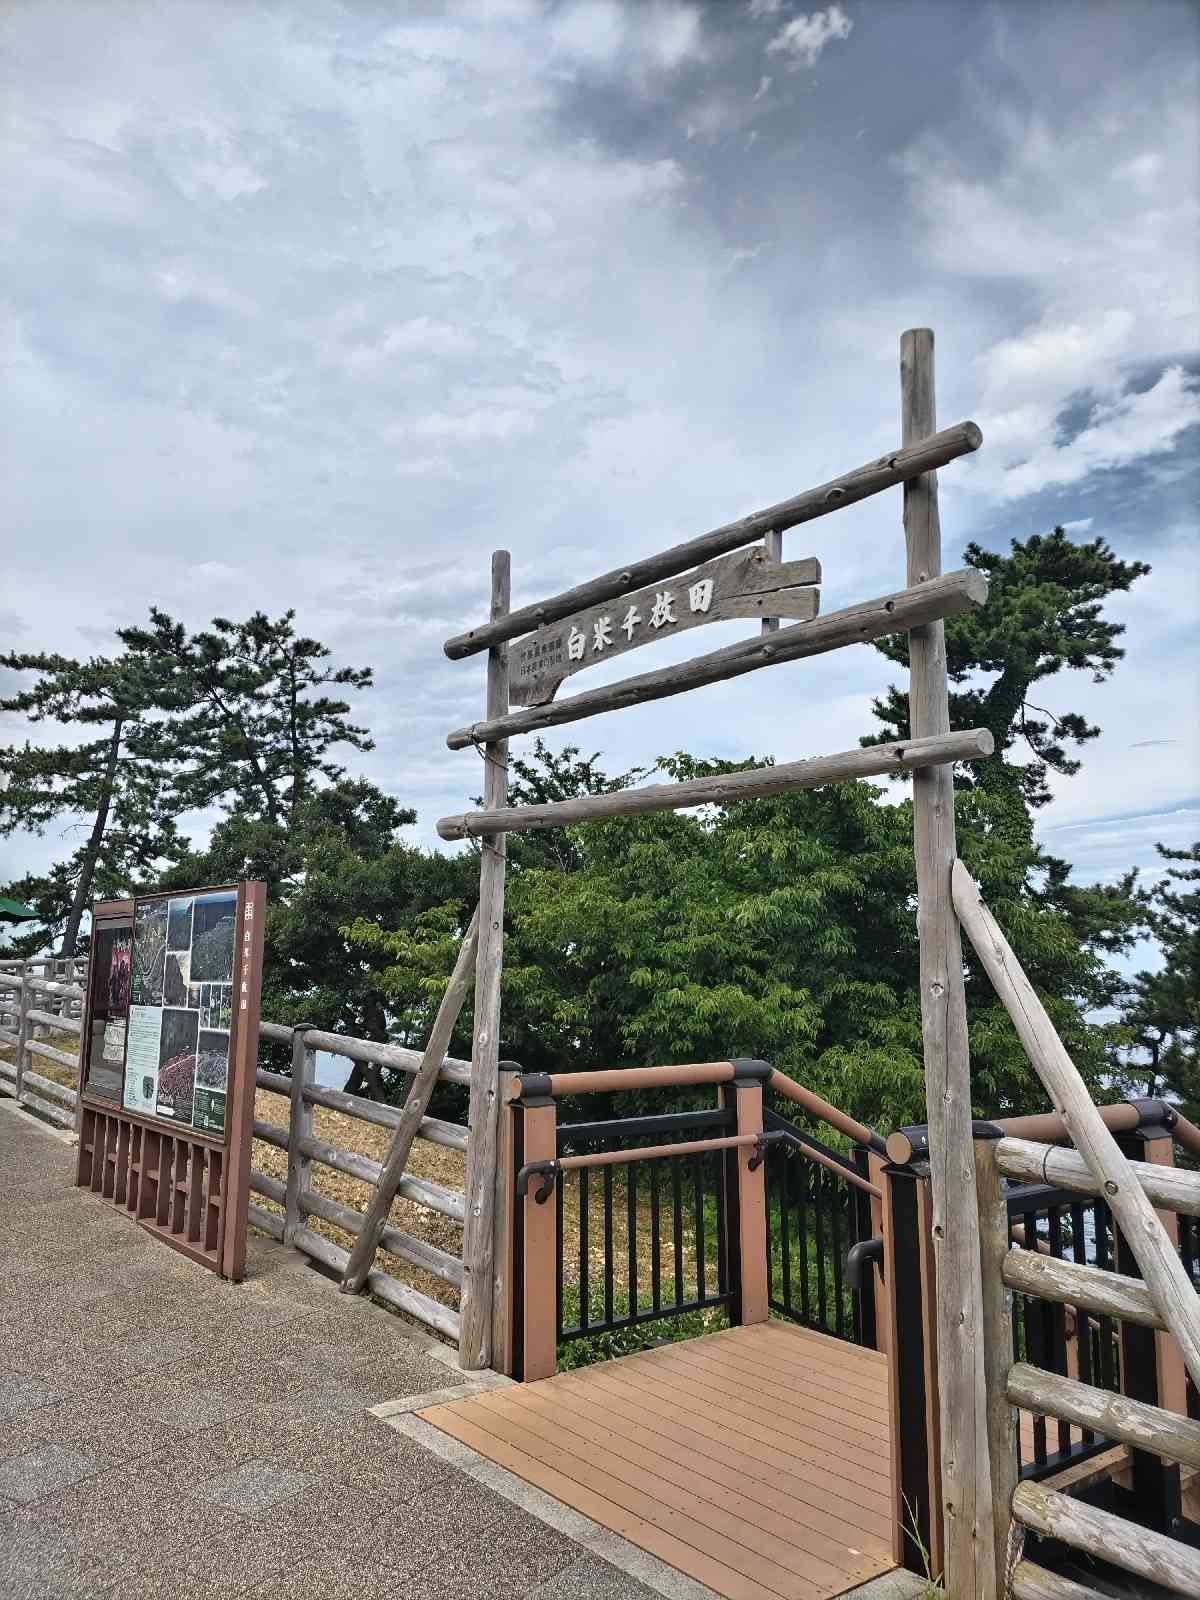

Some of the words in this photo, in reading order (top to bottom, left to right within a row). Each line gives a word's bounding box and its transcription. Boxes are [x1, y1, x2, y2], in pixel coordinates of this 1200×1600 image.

[567, 578, 715, 661] 白米千枚田
